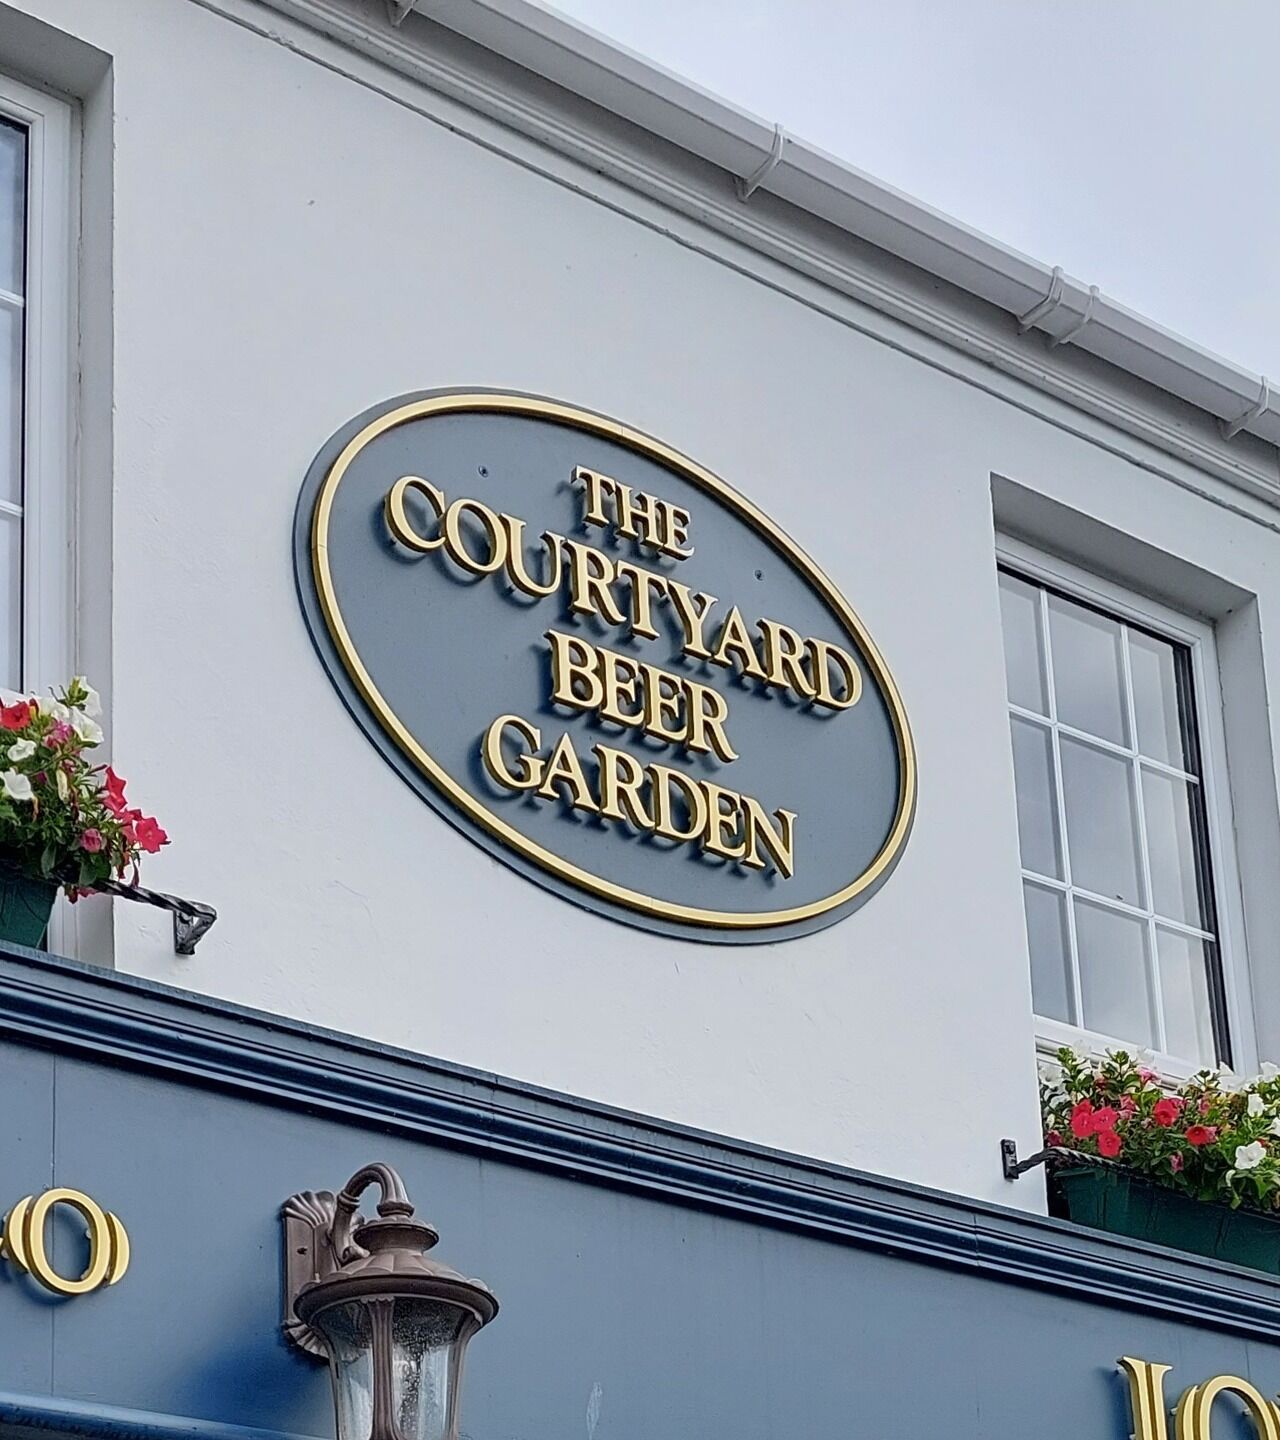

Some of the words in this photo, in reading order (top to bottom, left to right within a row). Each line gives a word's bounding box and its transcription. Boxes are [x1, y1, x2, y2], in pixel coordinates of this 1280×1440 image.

[571, 465, 695, 560] THE
[384, 475, 863, 710] COURTYARD
[543, 629, 739, 763] BEER
[481, 714, 798, 879] GARDEN
